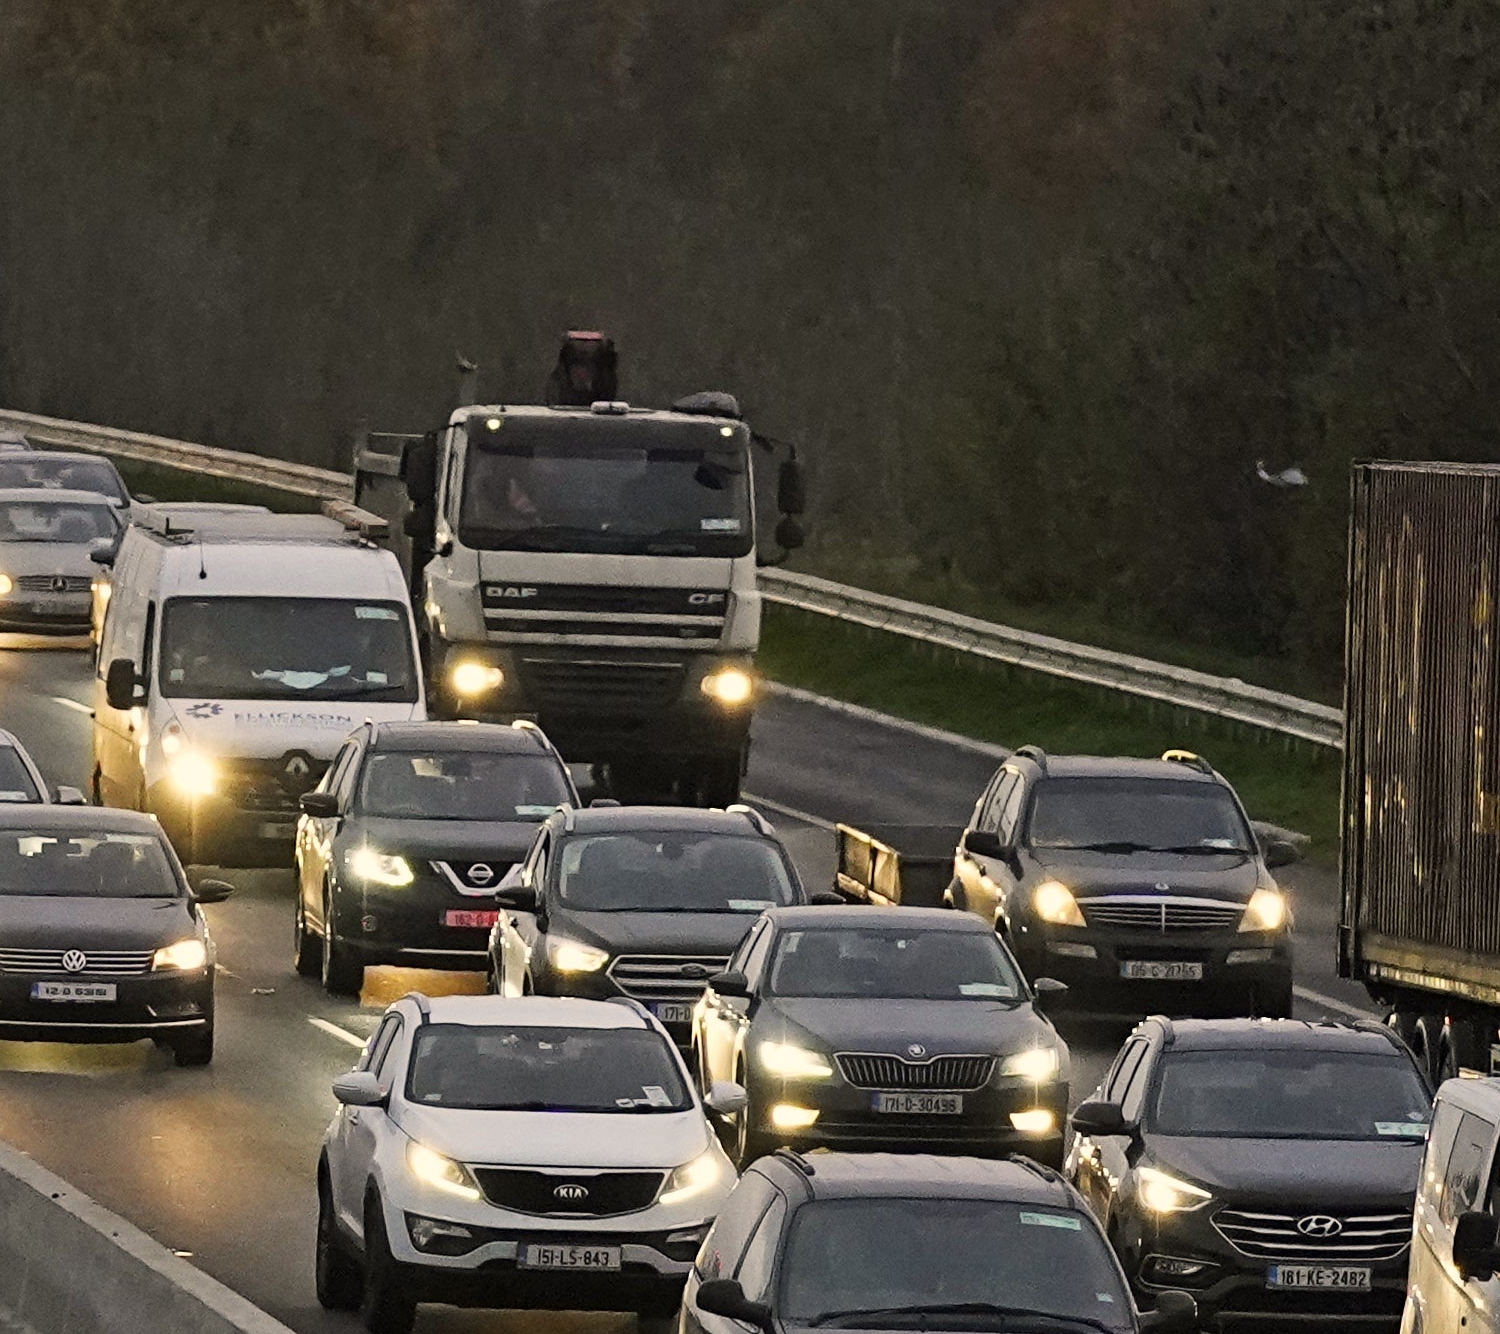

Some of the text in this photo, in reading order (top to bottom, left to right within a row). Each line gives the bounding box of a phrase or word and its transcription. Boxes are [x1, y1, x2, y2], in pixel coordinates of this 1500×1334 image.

[486, 586, 537, 598] DAF
[688, 593, 724, 605] CF
[560, 1188, 582, 1198] KIA
[537, 1247, 610, 1266] 151-LS-843
